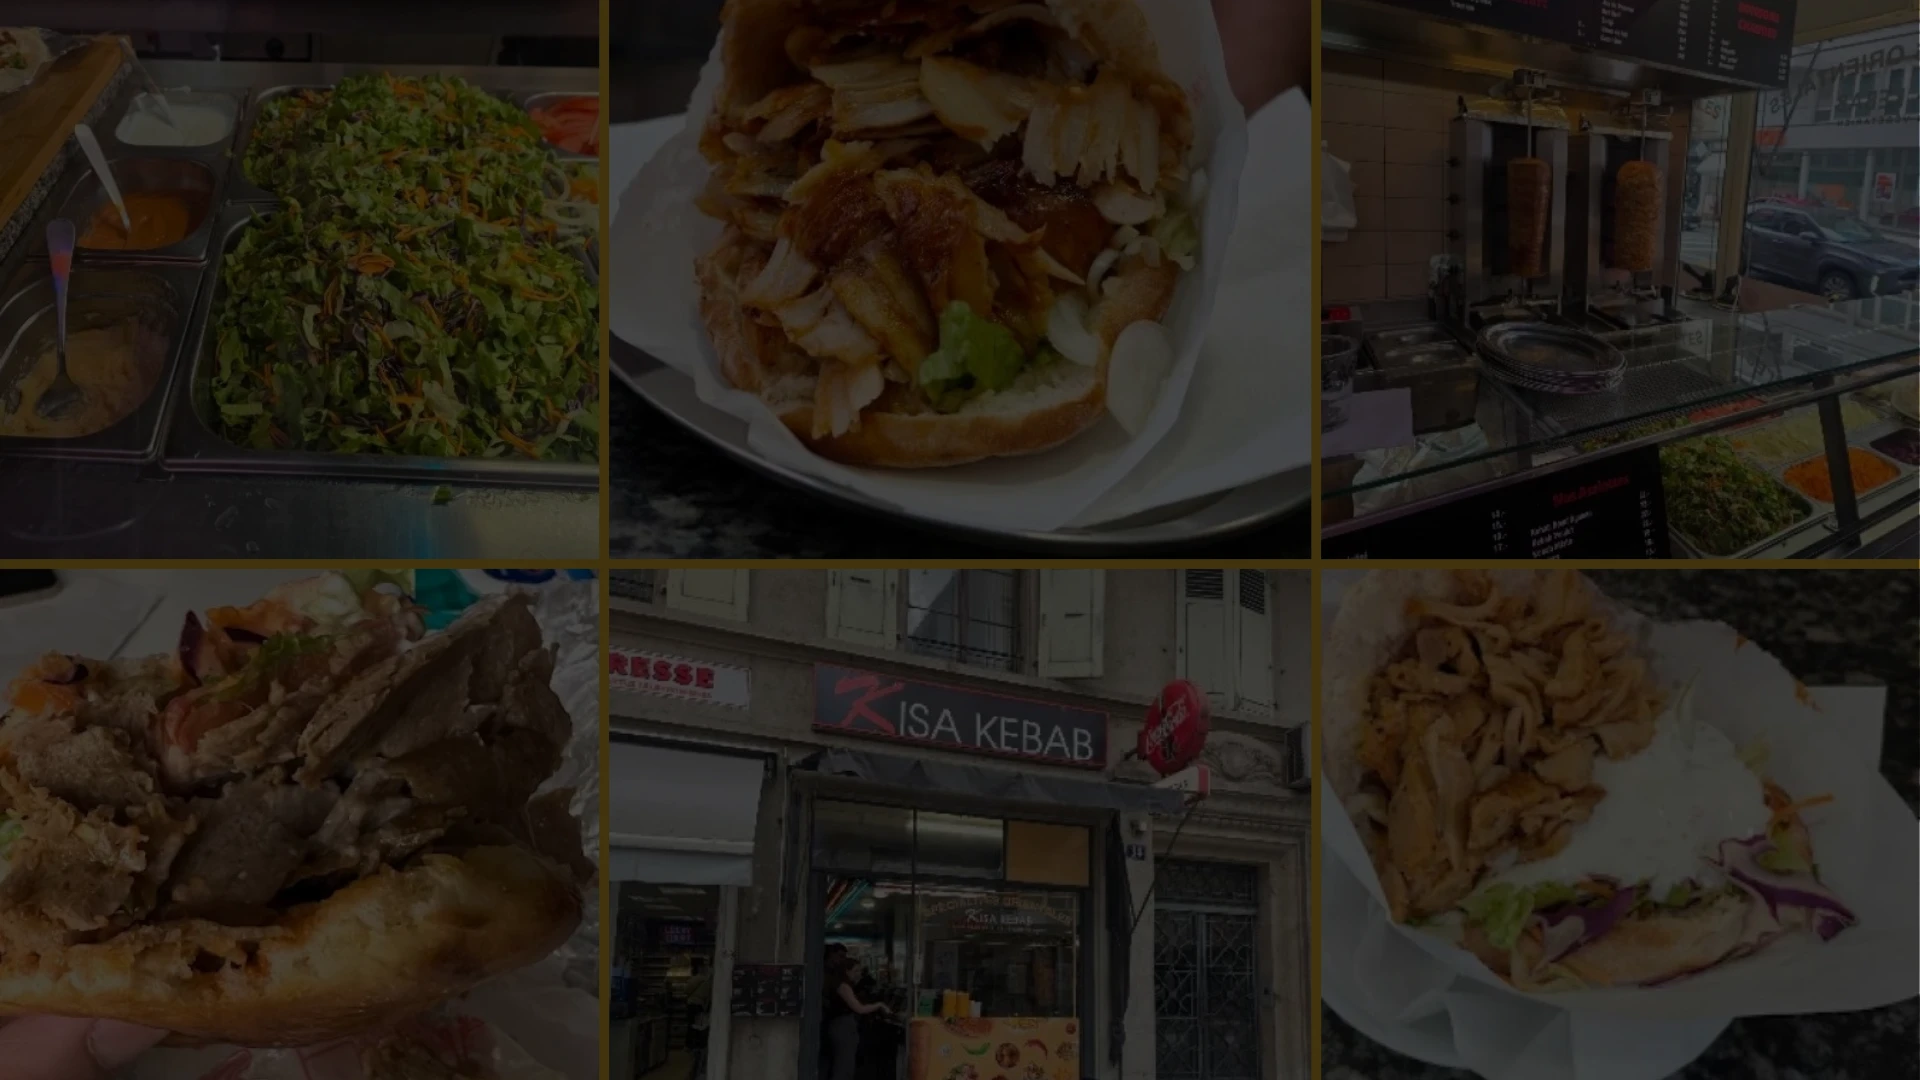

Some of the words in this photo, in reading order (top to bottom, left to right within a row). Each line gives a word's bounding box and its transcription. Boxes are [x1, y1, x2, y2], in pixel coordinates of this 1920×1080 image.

[609, 652, 715, 689] RESSE
[833, 674, 962, 744] KISA
[975, 711, 1094, 761] KEBAB
